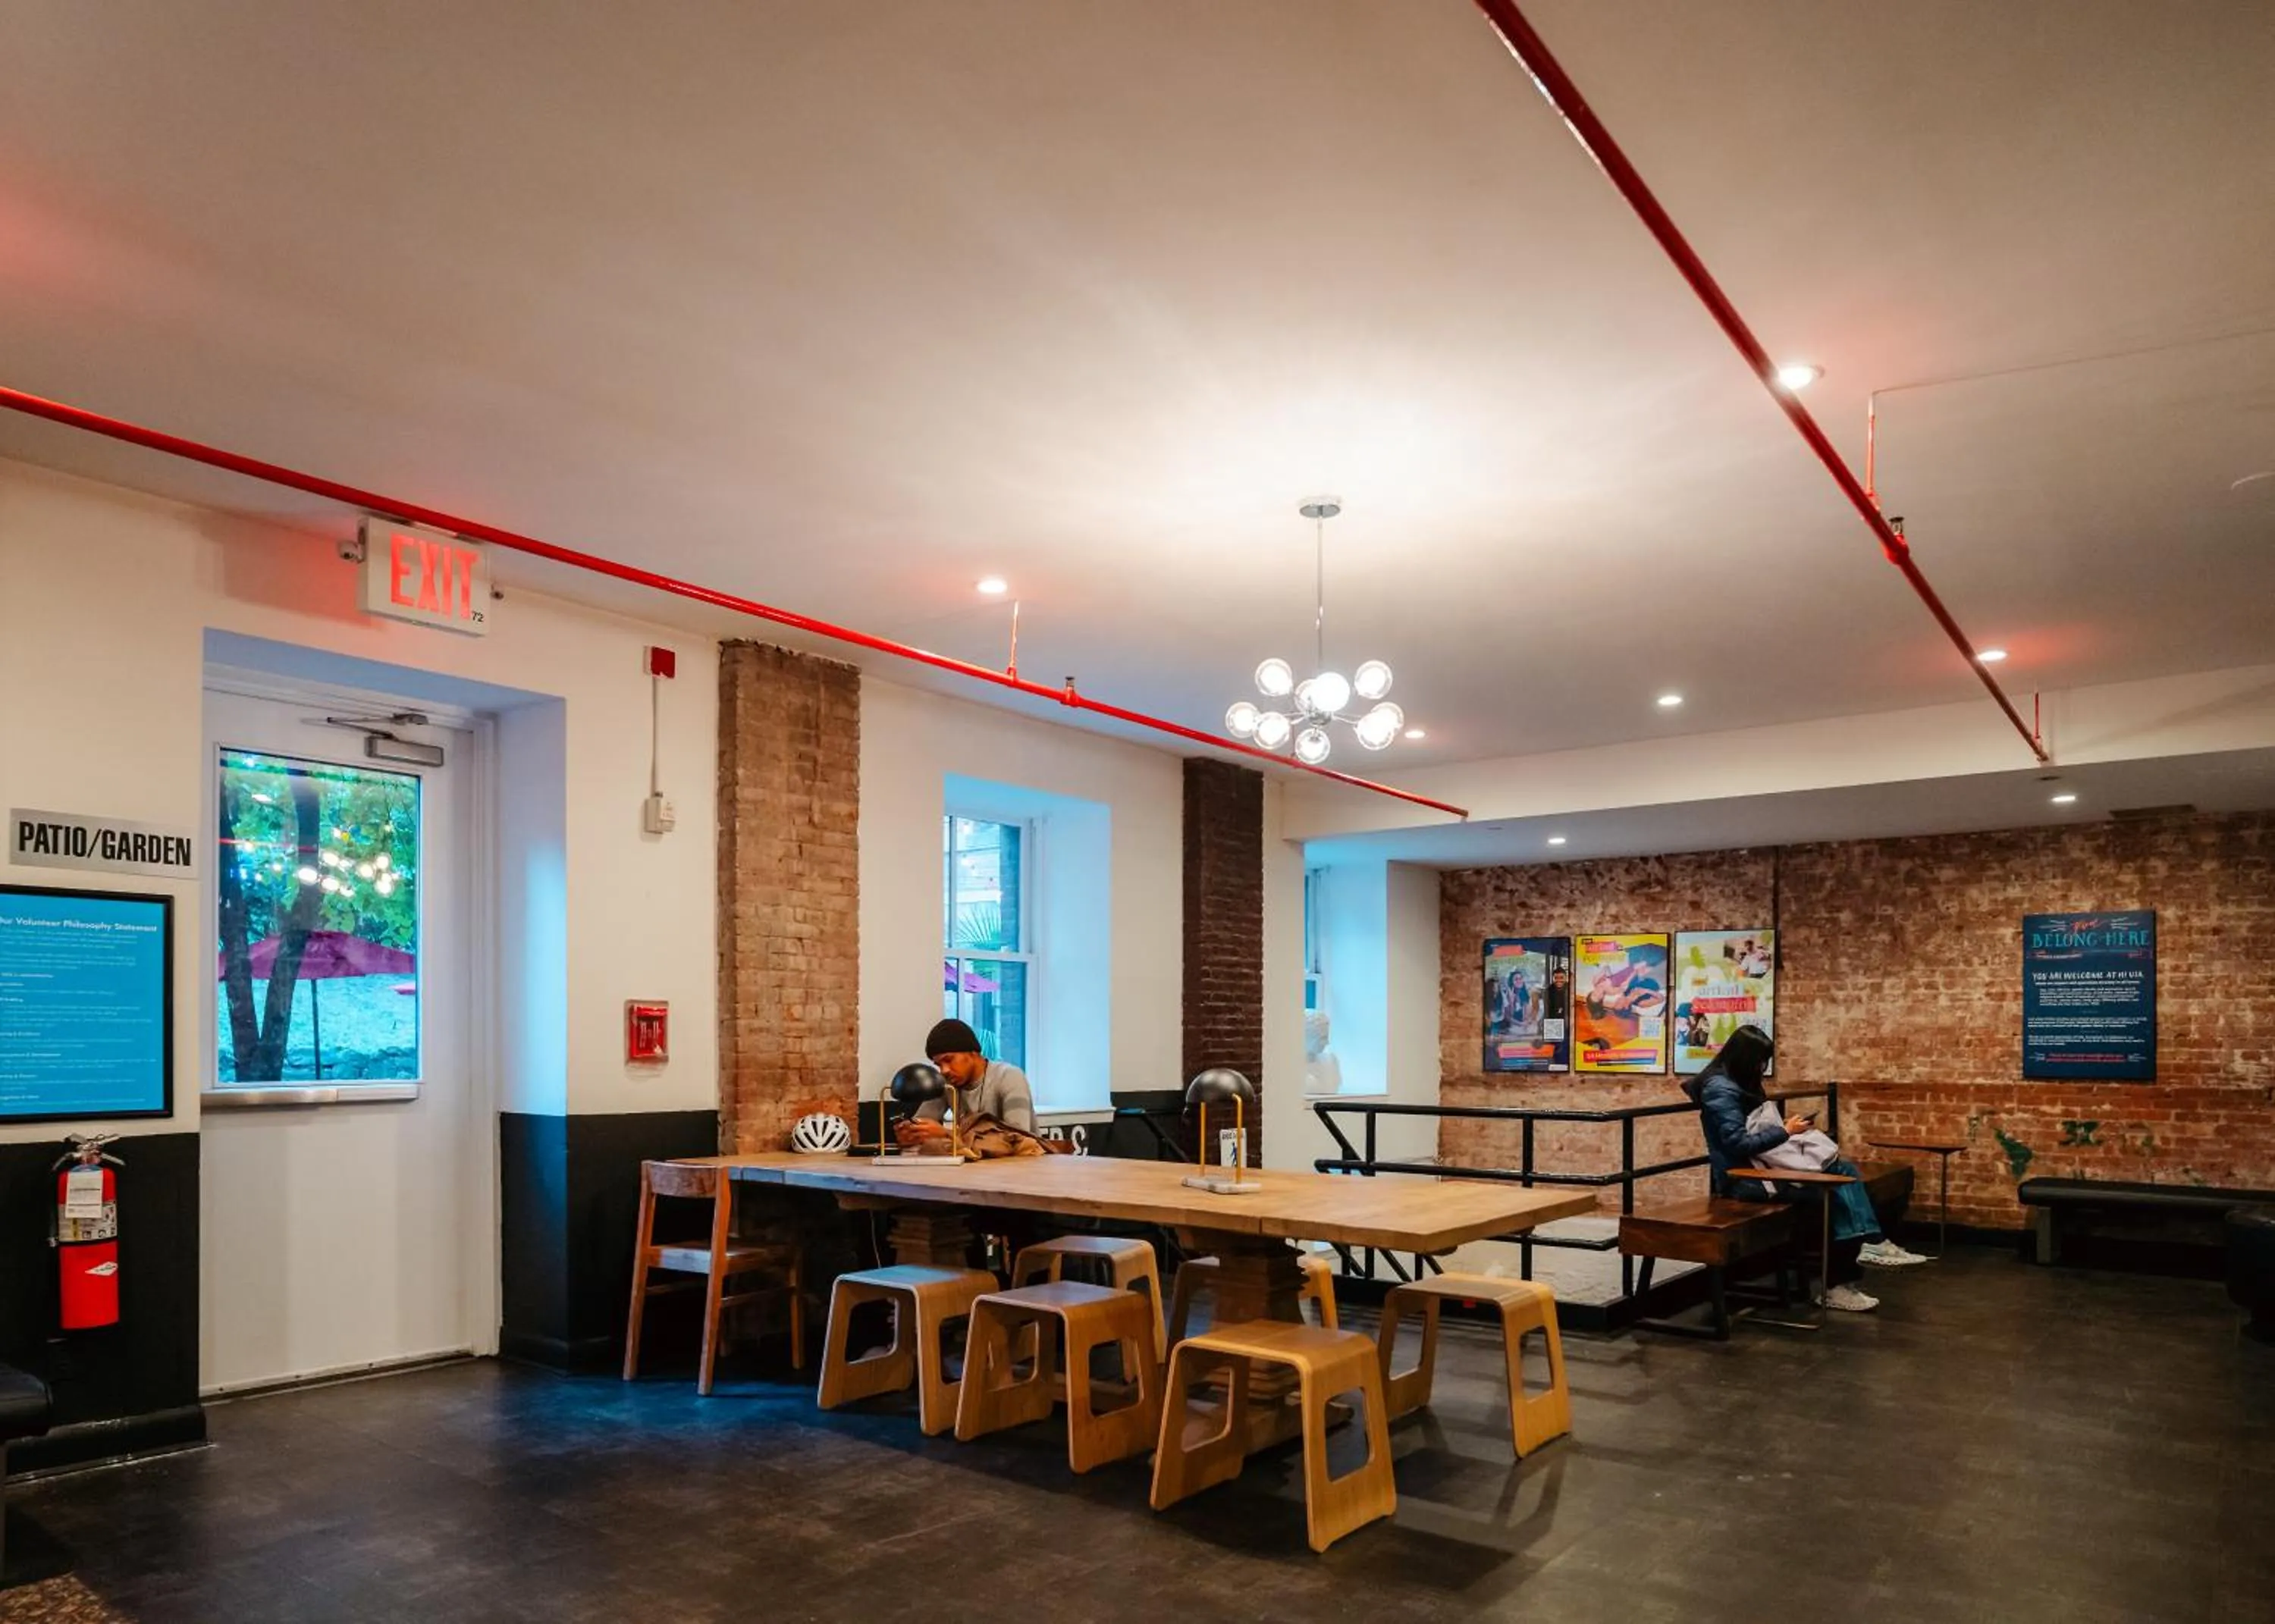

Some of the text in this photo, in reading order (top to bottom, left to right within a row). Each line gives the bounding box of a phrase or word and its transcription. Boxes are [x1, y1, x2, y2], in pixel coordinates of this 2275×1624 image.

[391, 533, 479, 619] EXIT
[472, 610, 484, 622] 72
[19, 821, 191, 866] PATIO/GARDEN
[15, 917, 61, 926] Volunteer
[63, 919, 111, 931] Philosophy
[115, 923, 157, 932] Statement
[2032, 930, 2149, 948] BELONG HERE
[2063, 970, 2104, 980] WELCOME
[2106, 970, 2116, 980] AT
